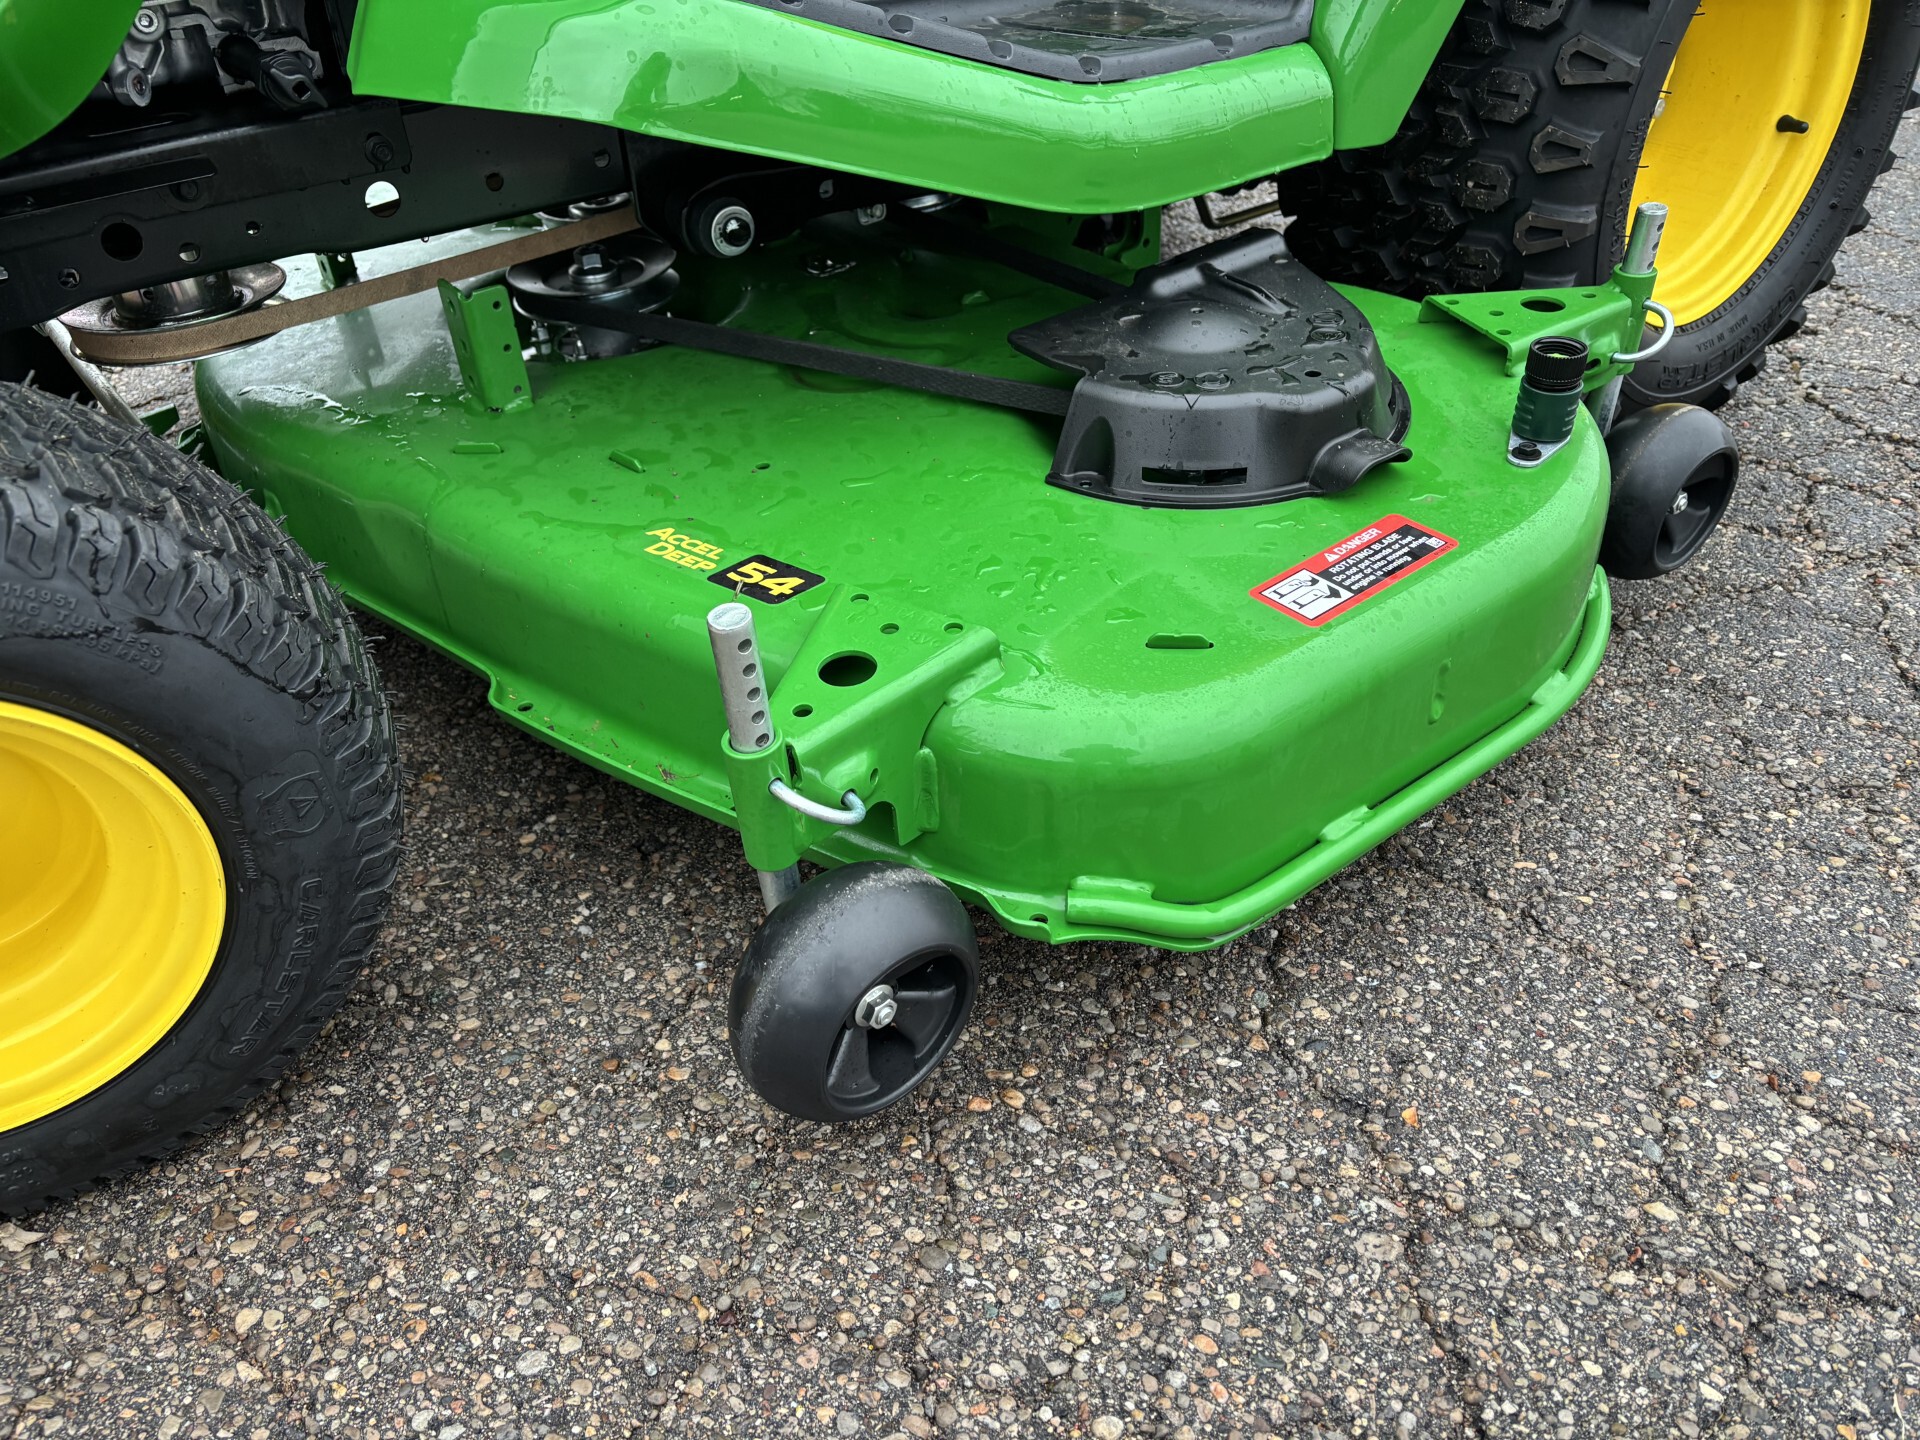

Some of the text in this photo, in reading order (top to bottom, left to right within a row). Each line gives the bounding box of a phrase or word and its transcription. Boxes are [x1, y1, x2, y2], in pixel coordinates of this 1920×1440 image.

[644, 541, 717, 570] DEEP
[645, 527, 724, 560] ACCEL
[1329, 532, 1402, 574] ROTATING BLADE
[1332, 535, 1415, 582] Do not put hands or feet
[1333, 527, 1382, 555] DANGER
[726, 561, 805, 596] 54
[1342, 536, 1430, 586] under or into mower when
[1350, 555, 1412, 591] engine is running
[56, 608, 162, 657] TUBELESS
[228, 877, 324, 1057] CARLSTAR
